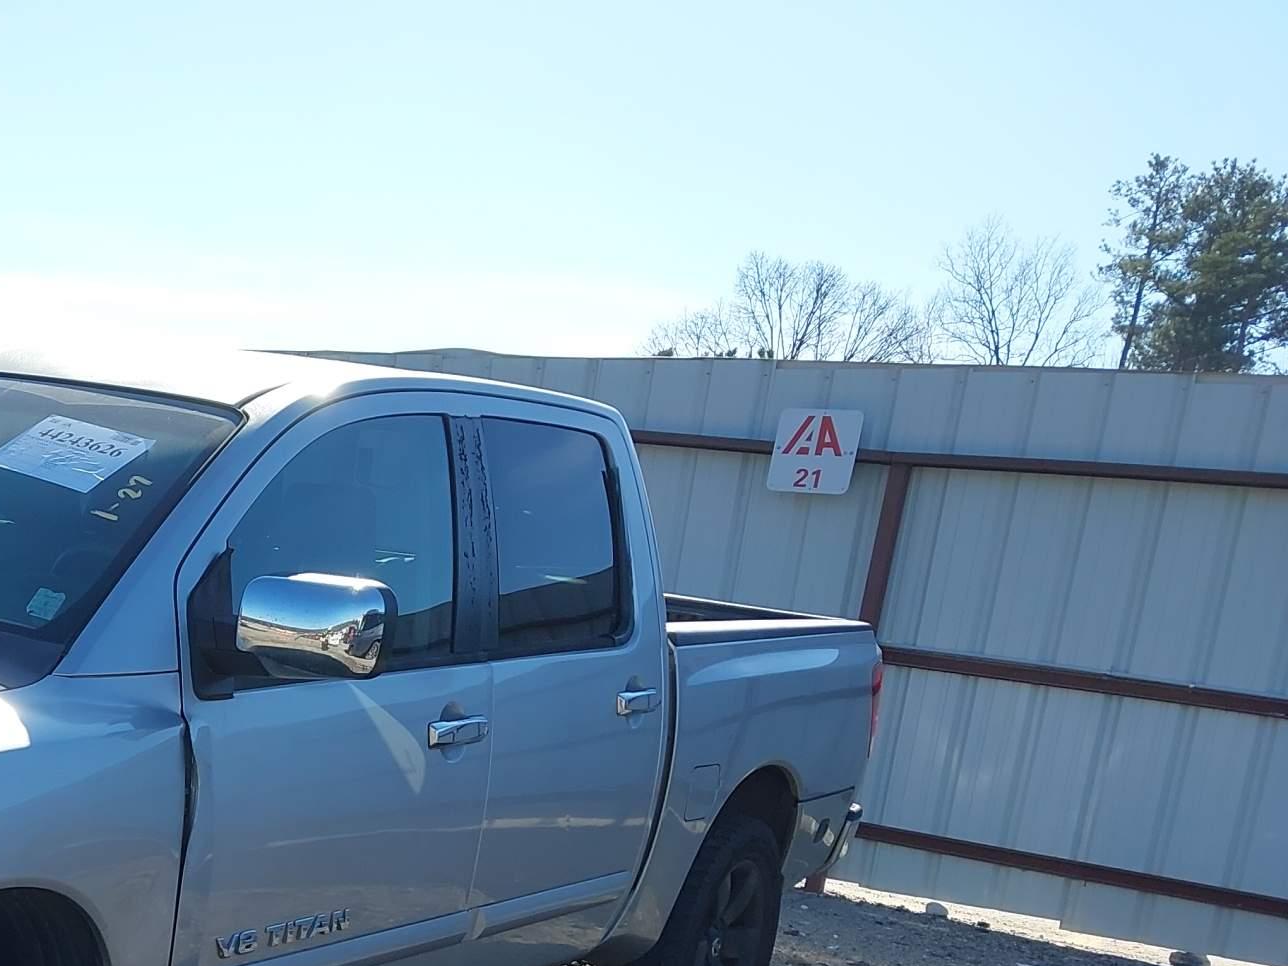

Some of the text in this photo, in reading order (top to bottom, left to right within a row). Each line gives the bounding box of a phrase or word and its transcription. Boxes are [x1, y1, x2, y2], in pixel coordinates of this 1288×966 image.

[38, 428, 128, 458] 44243626
[793, 468, 822, 489] 21
[216, 908, 351, 959] V8 TITAN
